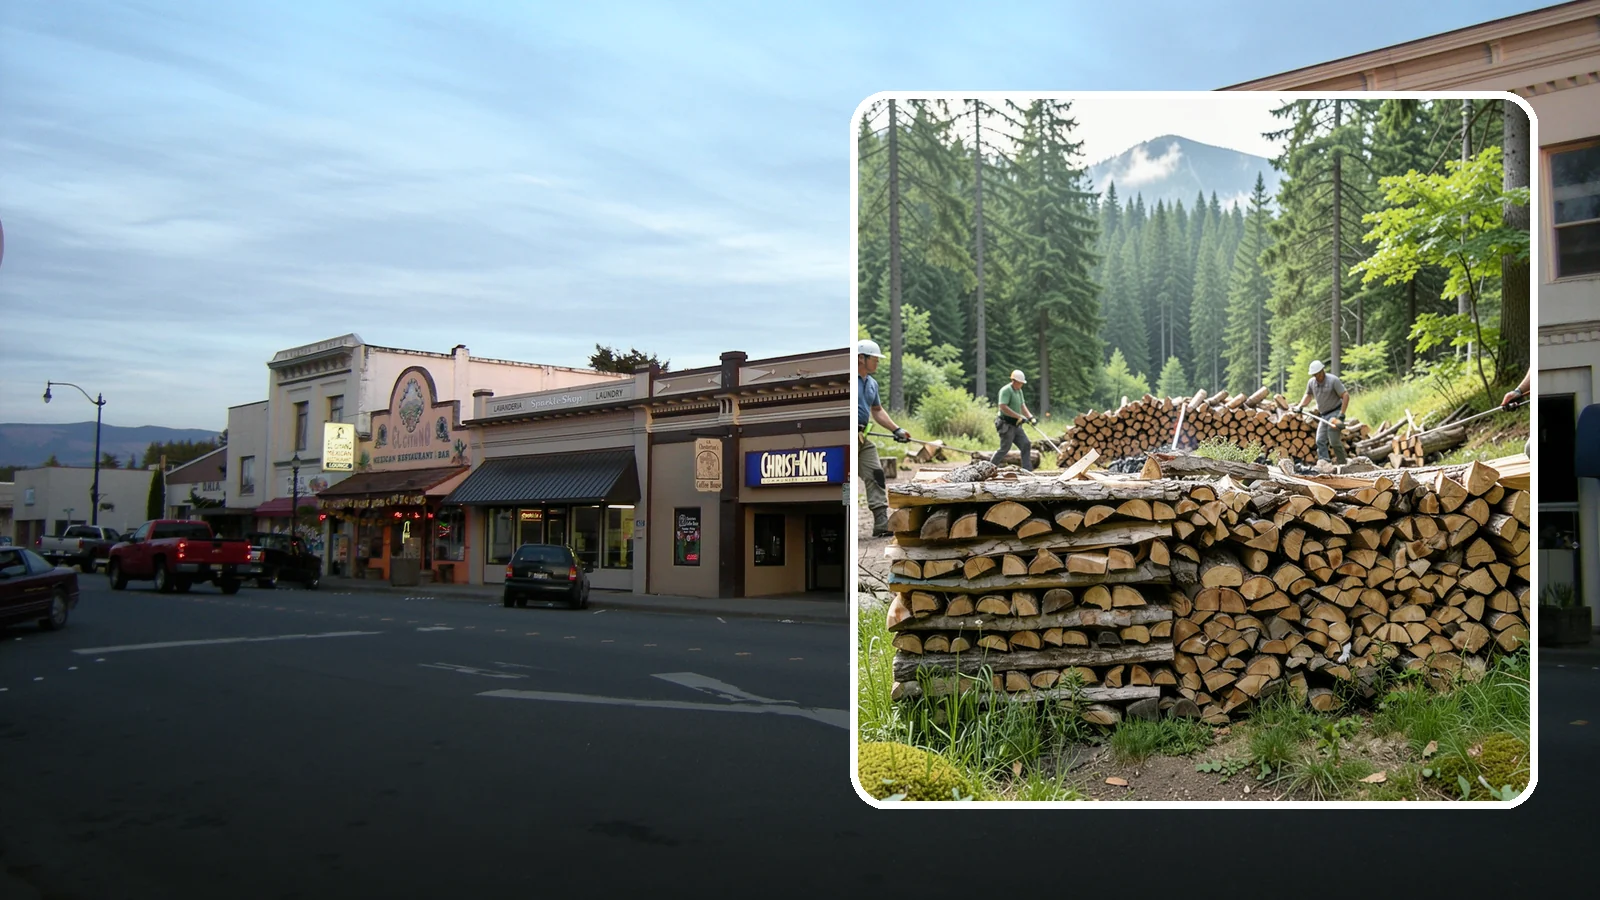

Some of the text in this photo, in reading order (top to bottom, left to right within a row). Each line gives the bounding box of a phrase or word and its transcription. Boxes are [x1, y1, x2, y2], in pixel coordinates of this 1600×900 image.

[595, 388, 624, 400] LAUNDRY
[493, 402, 523, 413] LAVANDERIA
[530, 394, 583, 410] Sparkle Shop
[373, 454, 396, 464] MEXICAN
[397, 451, 434, 463] RESTAURANT
[438, 450, 450, 460] BAR
[761, 450, 828, 479] CHRIST KING
